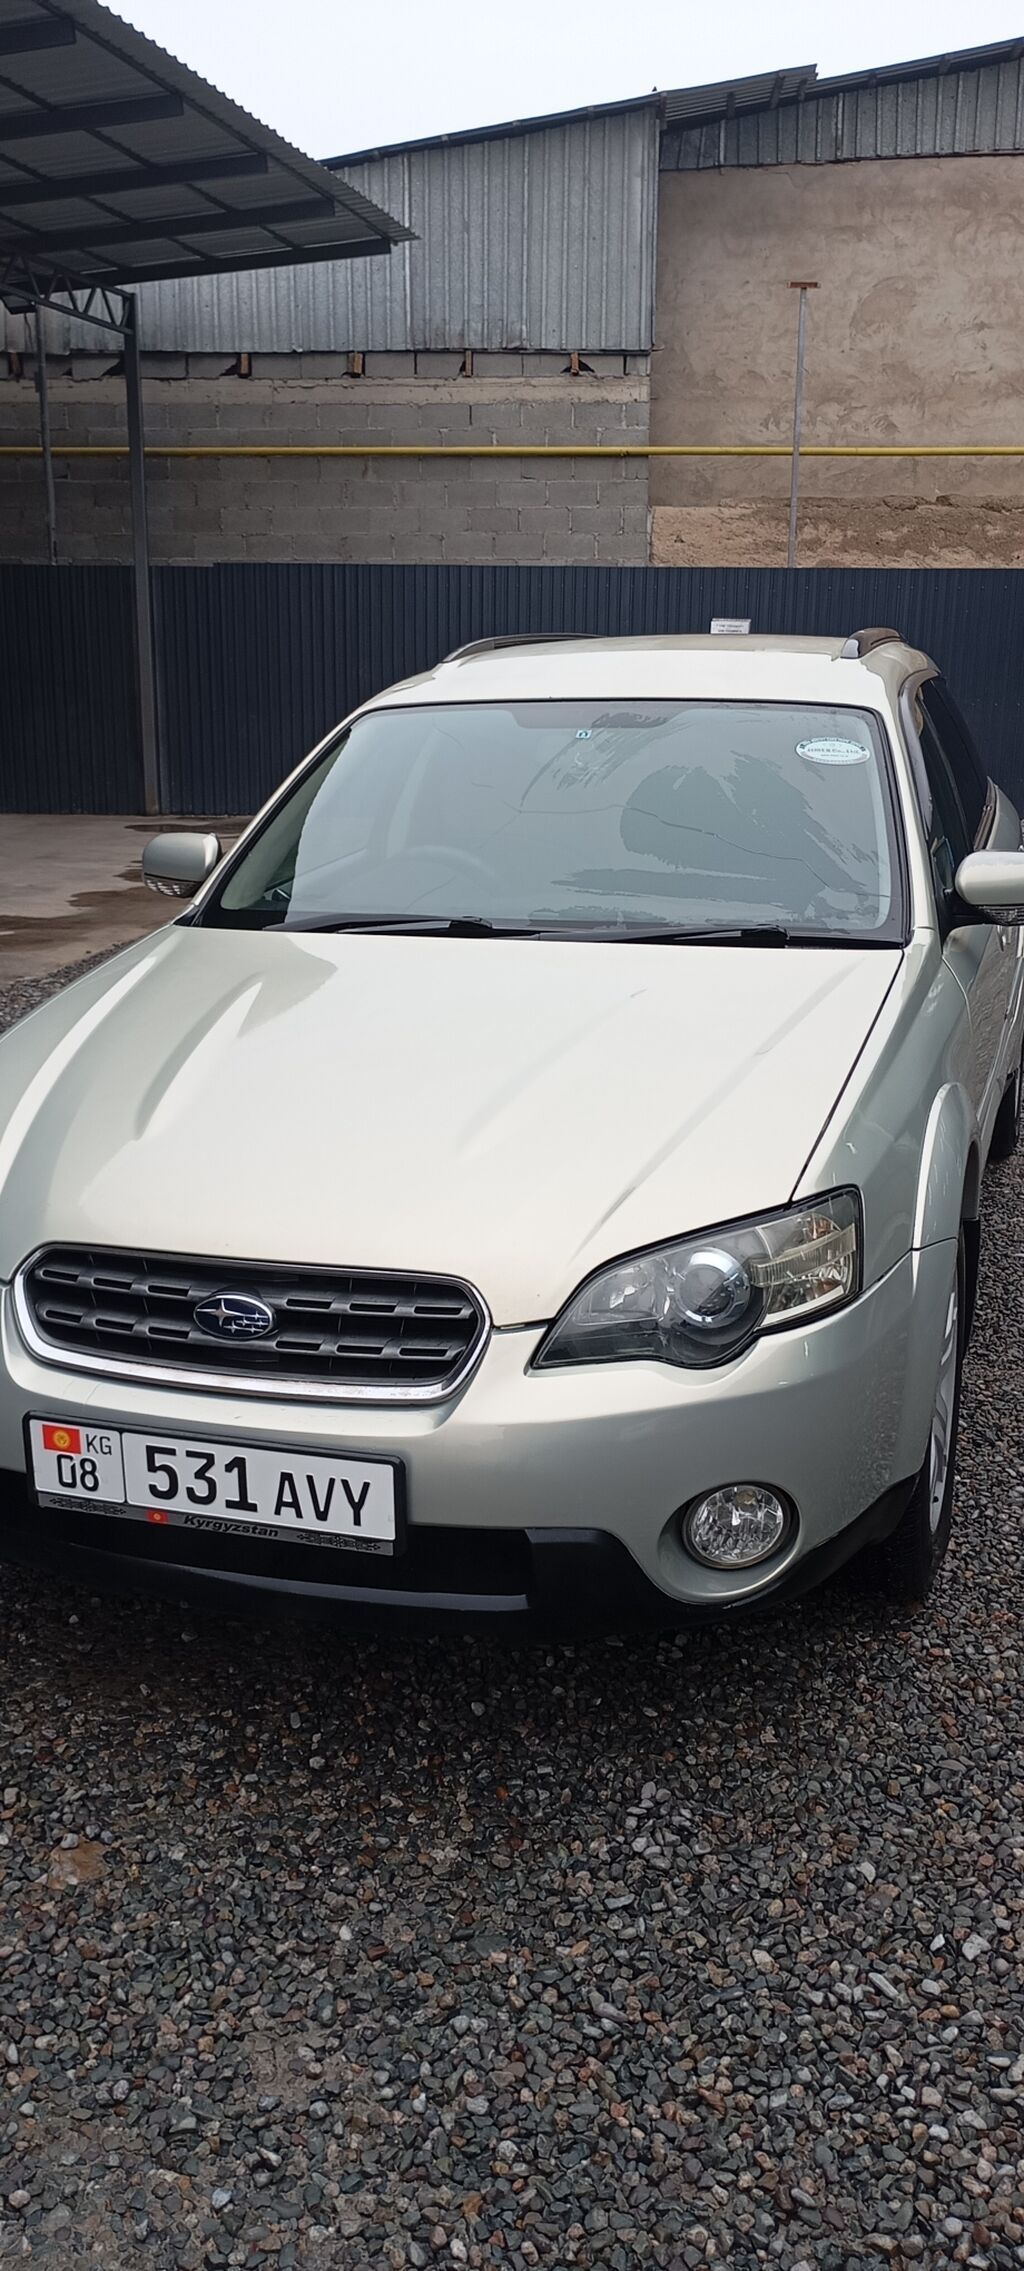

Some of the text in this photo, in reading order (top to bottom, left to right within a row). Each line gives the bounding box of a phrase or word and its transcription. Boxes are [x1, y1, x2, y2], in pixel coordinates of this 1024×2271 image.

[85, 1433, 113, 1456] KG
[56, 1453, 100, 1492] 08
[145, 1444, 371, 1527] 531 AVY
[183, 1515, 279, 1538] Kyrgyzstan
